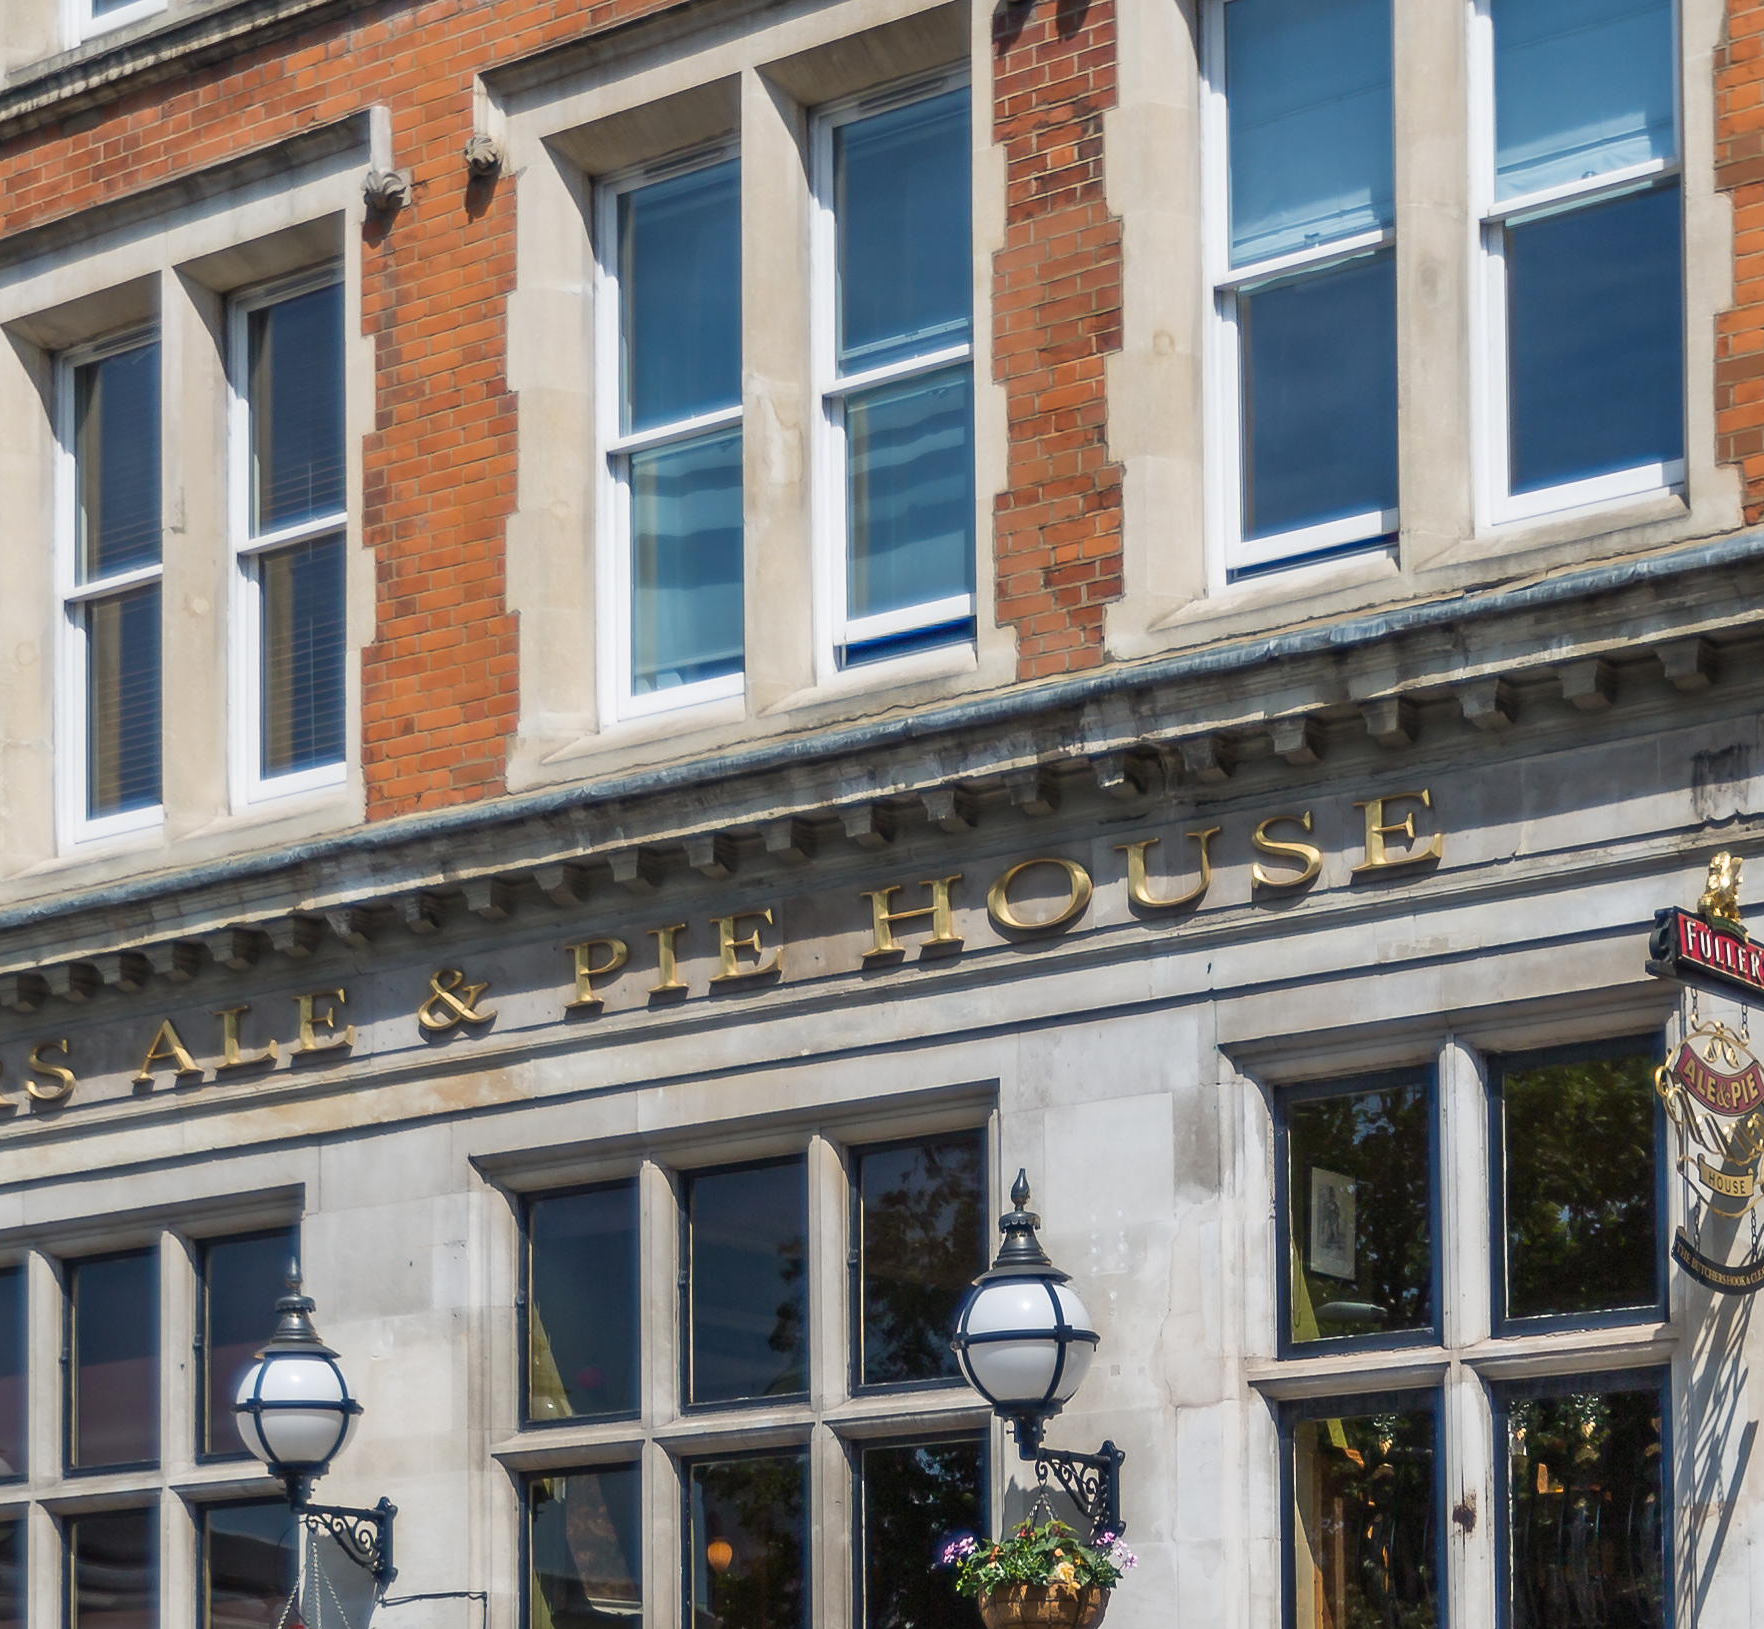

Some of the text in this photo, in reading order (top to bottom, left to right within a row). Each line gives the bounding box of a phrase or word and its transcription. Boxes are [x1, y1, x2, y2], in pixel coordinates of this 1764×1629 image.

[131, 988, 356, 1083] ALE
[418, 969, 497, 1032] &
[563, 908, 784, 1009] PIE
[860, 788, 1443, 958] HOUSE
[1708, 1172, 1747, 1195] HOUSE
[1677, 1244, 1692, 1265] THE
[1691, 1257, 1727, 1286] BUTCHERS
[1726, 1274, 1747, 1287] HOOK
